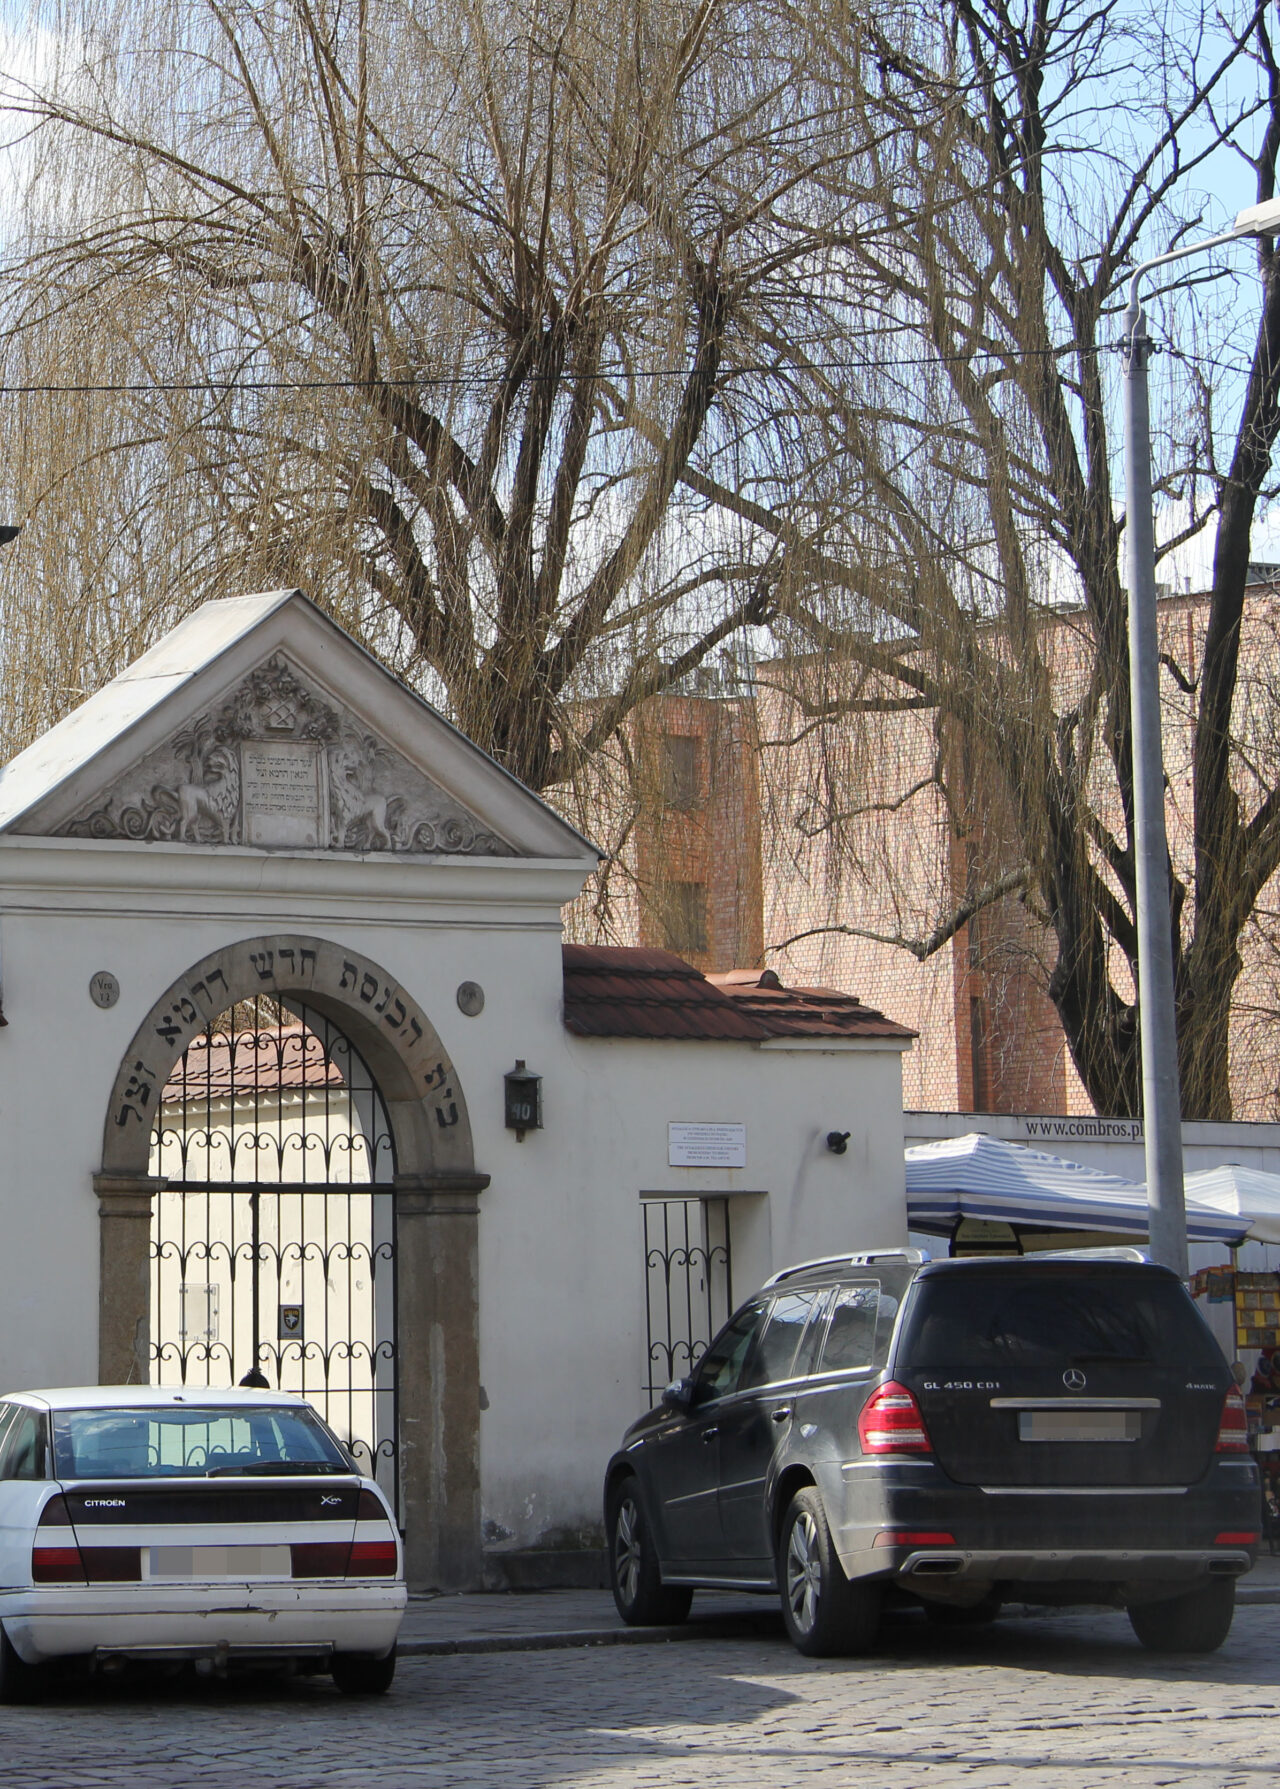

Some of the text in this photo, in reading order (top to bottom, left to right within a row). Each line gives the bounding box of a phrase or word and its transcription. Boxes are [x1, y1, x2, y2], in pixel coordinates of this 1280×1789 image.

[249, 948, 316, 980] חדש
[339, 960, 423, 1048] הכנסת
[424, 1063, 459, 1128] בית
[1026, 1119, 1144, 1141] www.combros.pl
[923, 1381, 1000, 1390] GL 450 CDI
[84, 1499, 126, 1507] CITROËN
